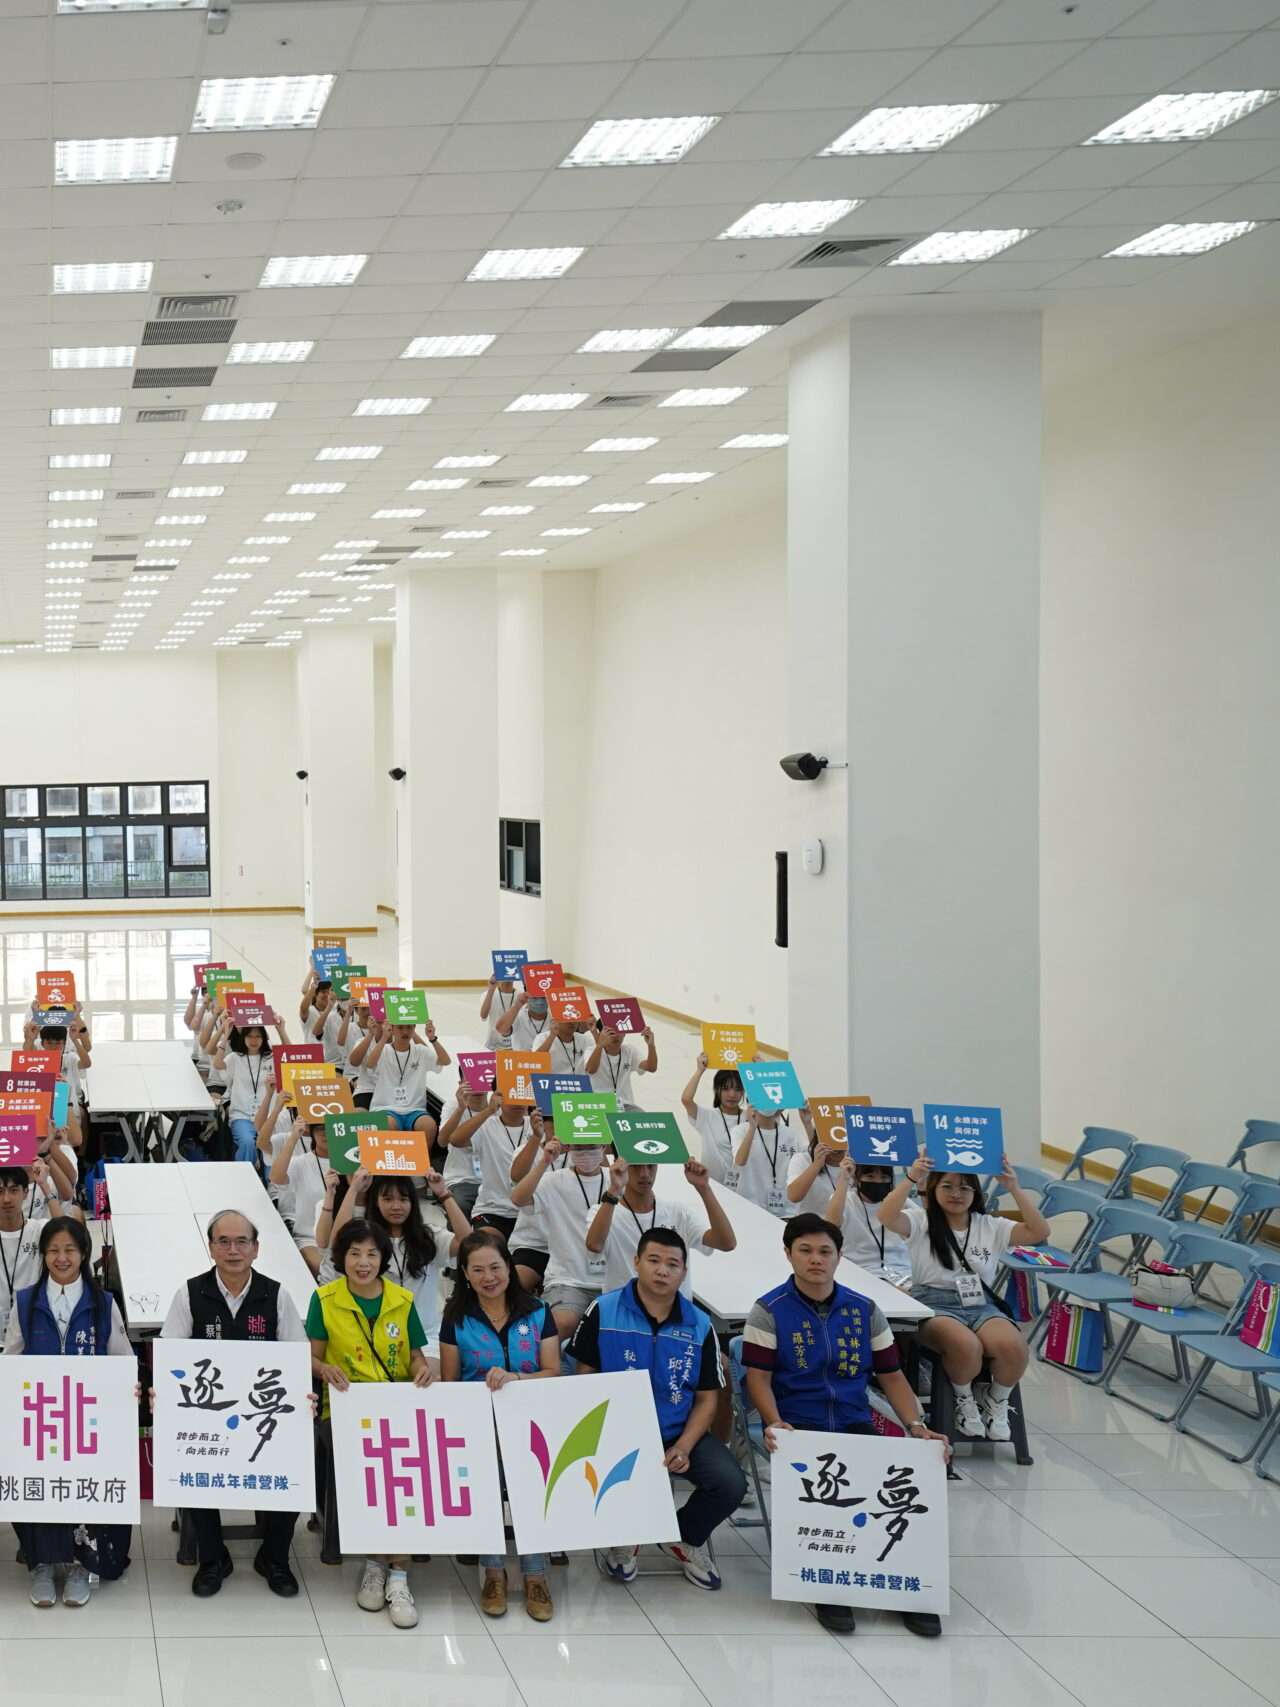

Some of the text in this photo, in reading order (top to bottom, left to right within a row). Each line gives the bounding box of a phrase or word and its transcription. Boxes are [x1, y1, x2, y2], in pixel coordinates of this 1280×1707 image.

[335, 970, 342, 978] 13
[370, 992, 379, 1001] 10
[390, 995, 398, 1004] 15
[710, 1029, 717, 1041] 7
[18, 1055, 25, 1064] 5
[281, 1052, 288, 1063] 4
[463, 1058, 475, 1068] 10
[505, 1058, 512, 1070] 11
[290, 1069, 297, 1079] 7
[745, 1070, 754, 1081] 6
[6, 1079, 14, 1092] 8
[539, 1079, 549, 1089] 17
[300, 1085, 312, 1096] 12
[560, 1101, 573, 1112] 15
[818, 1104, 831, 1117] 12
[616, 1119, 632, 1132] 13
[850, 1114, 864, 1127] 16
[933, 1114, 948, 1130] 14
[333, 1122, 346, 1137] 13
[367, 1136, 379, 1147] 11
[680, 1343, 695, 1389] 立法委
[177, 1358, 296, 1463] 逐夢
[185, 1446, 231, 1457] 向光而行
[179, 1471, 290, 1491] 桃園成年禮營隊
[798, 1452, 930, 1562] 逐夢
[807, 1542, 857, 1555] 向光而行
[800, 1567, 922, 1593] 桃園成年禮營隊
